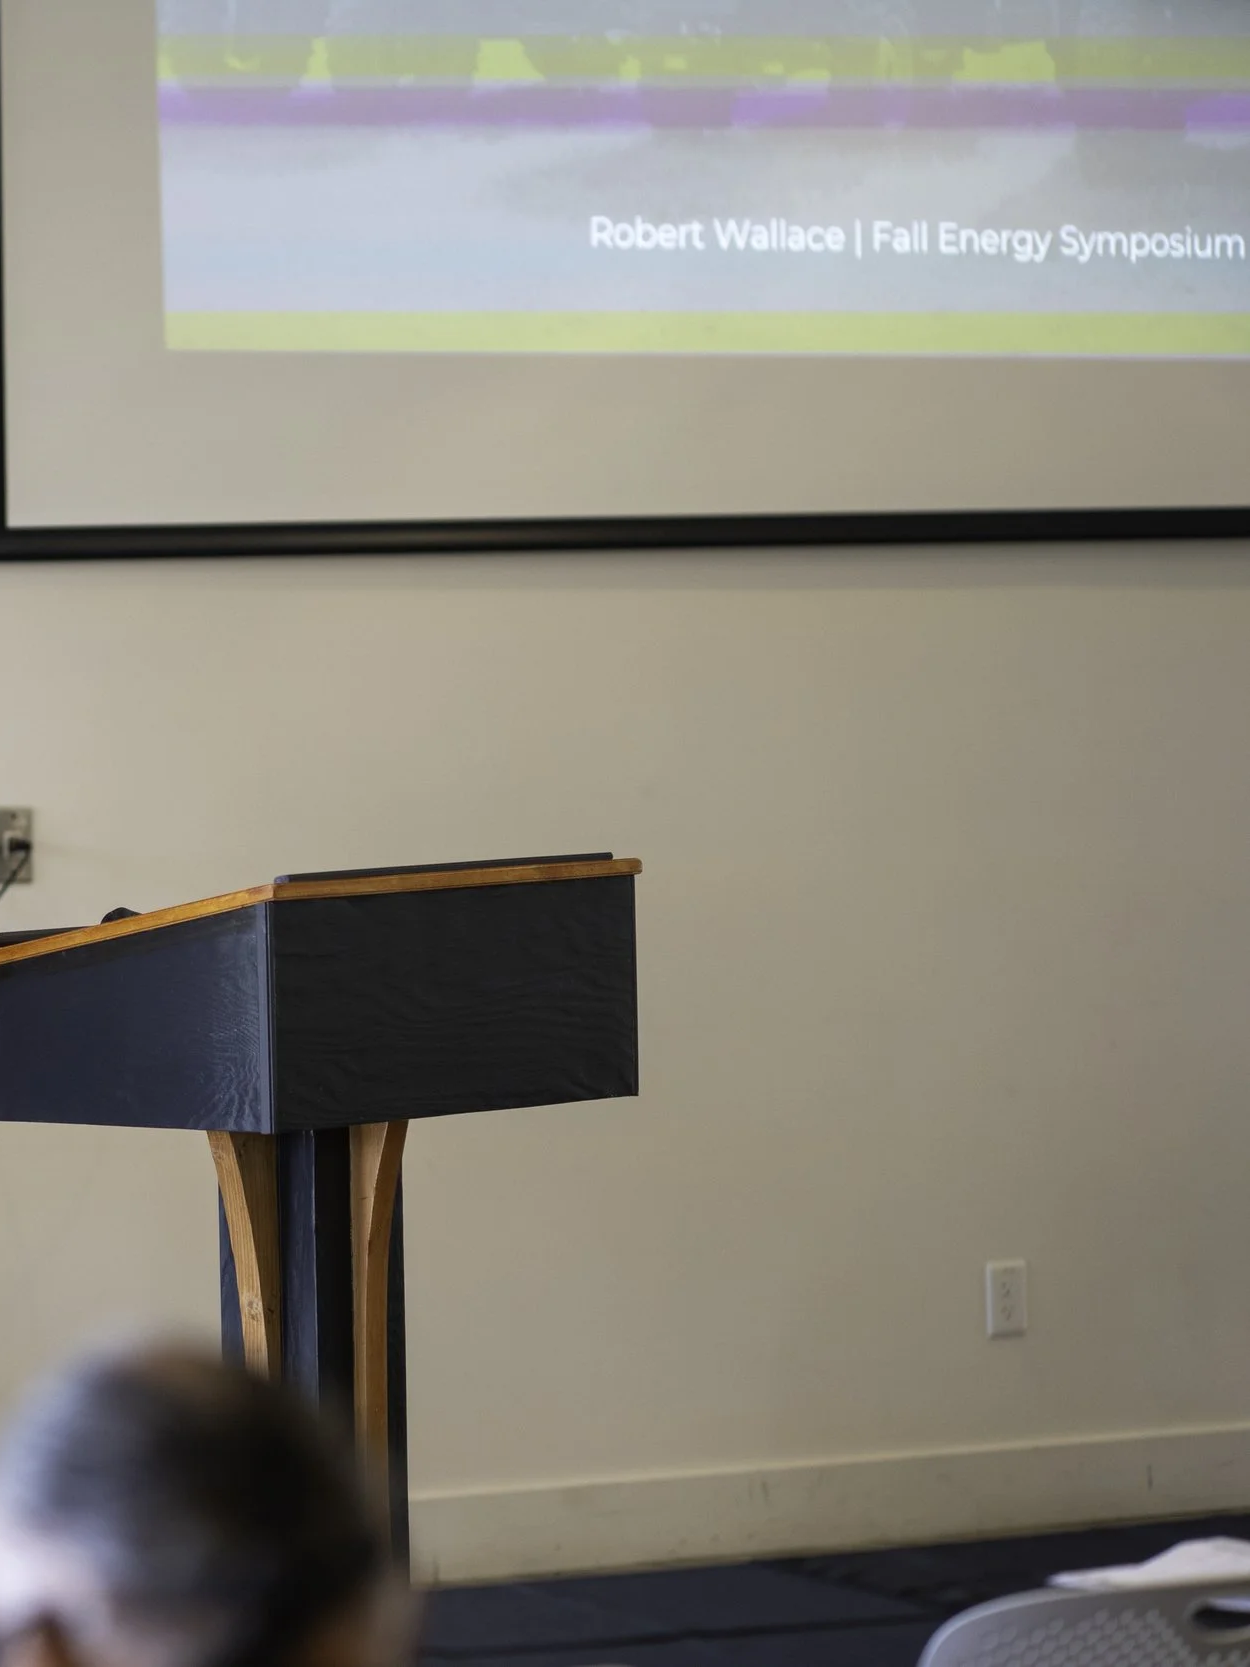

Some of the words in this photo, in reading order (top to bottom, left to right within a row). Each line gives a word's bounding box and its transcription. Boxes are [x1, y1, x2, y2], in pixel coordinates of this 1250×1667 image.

[591, 215, 705, 250] Robert
[713, 217, 845, 252] Wallace
[873, 220, 928, 255] Fall
[938, 221, 1052, 263] Energy
[1059, 224, 1245, 264] Symposium
